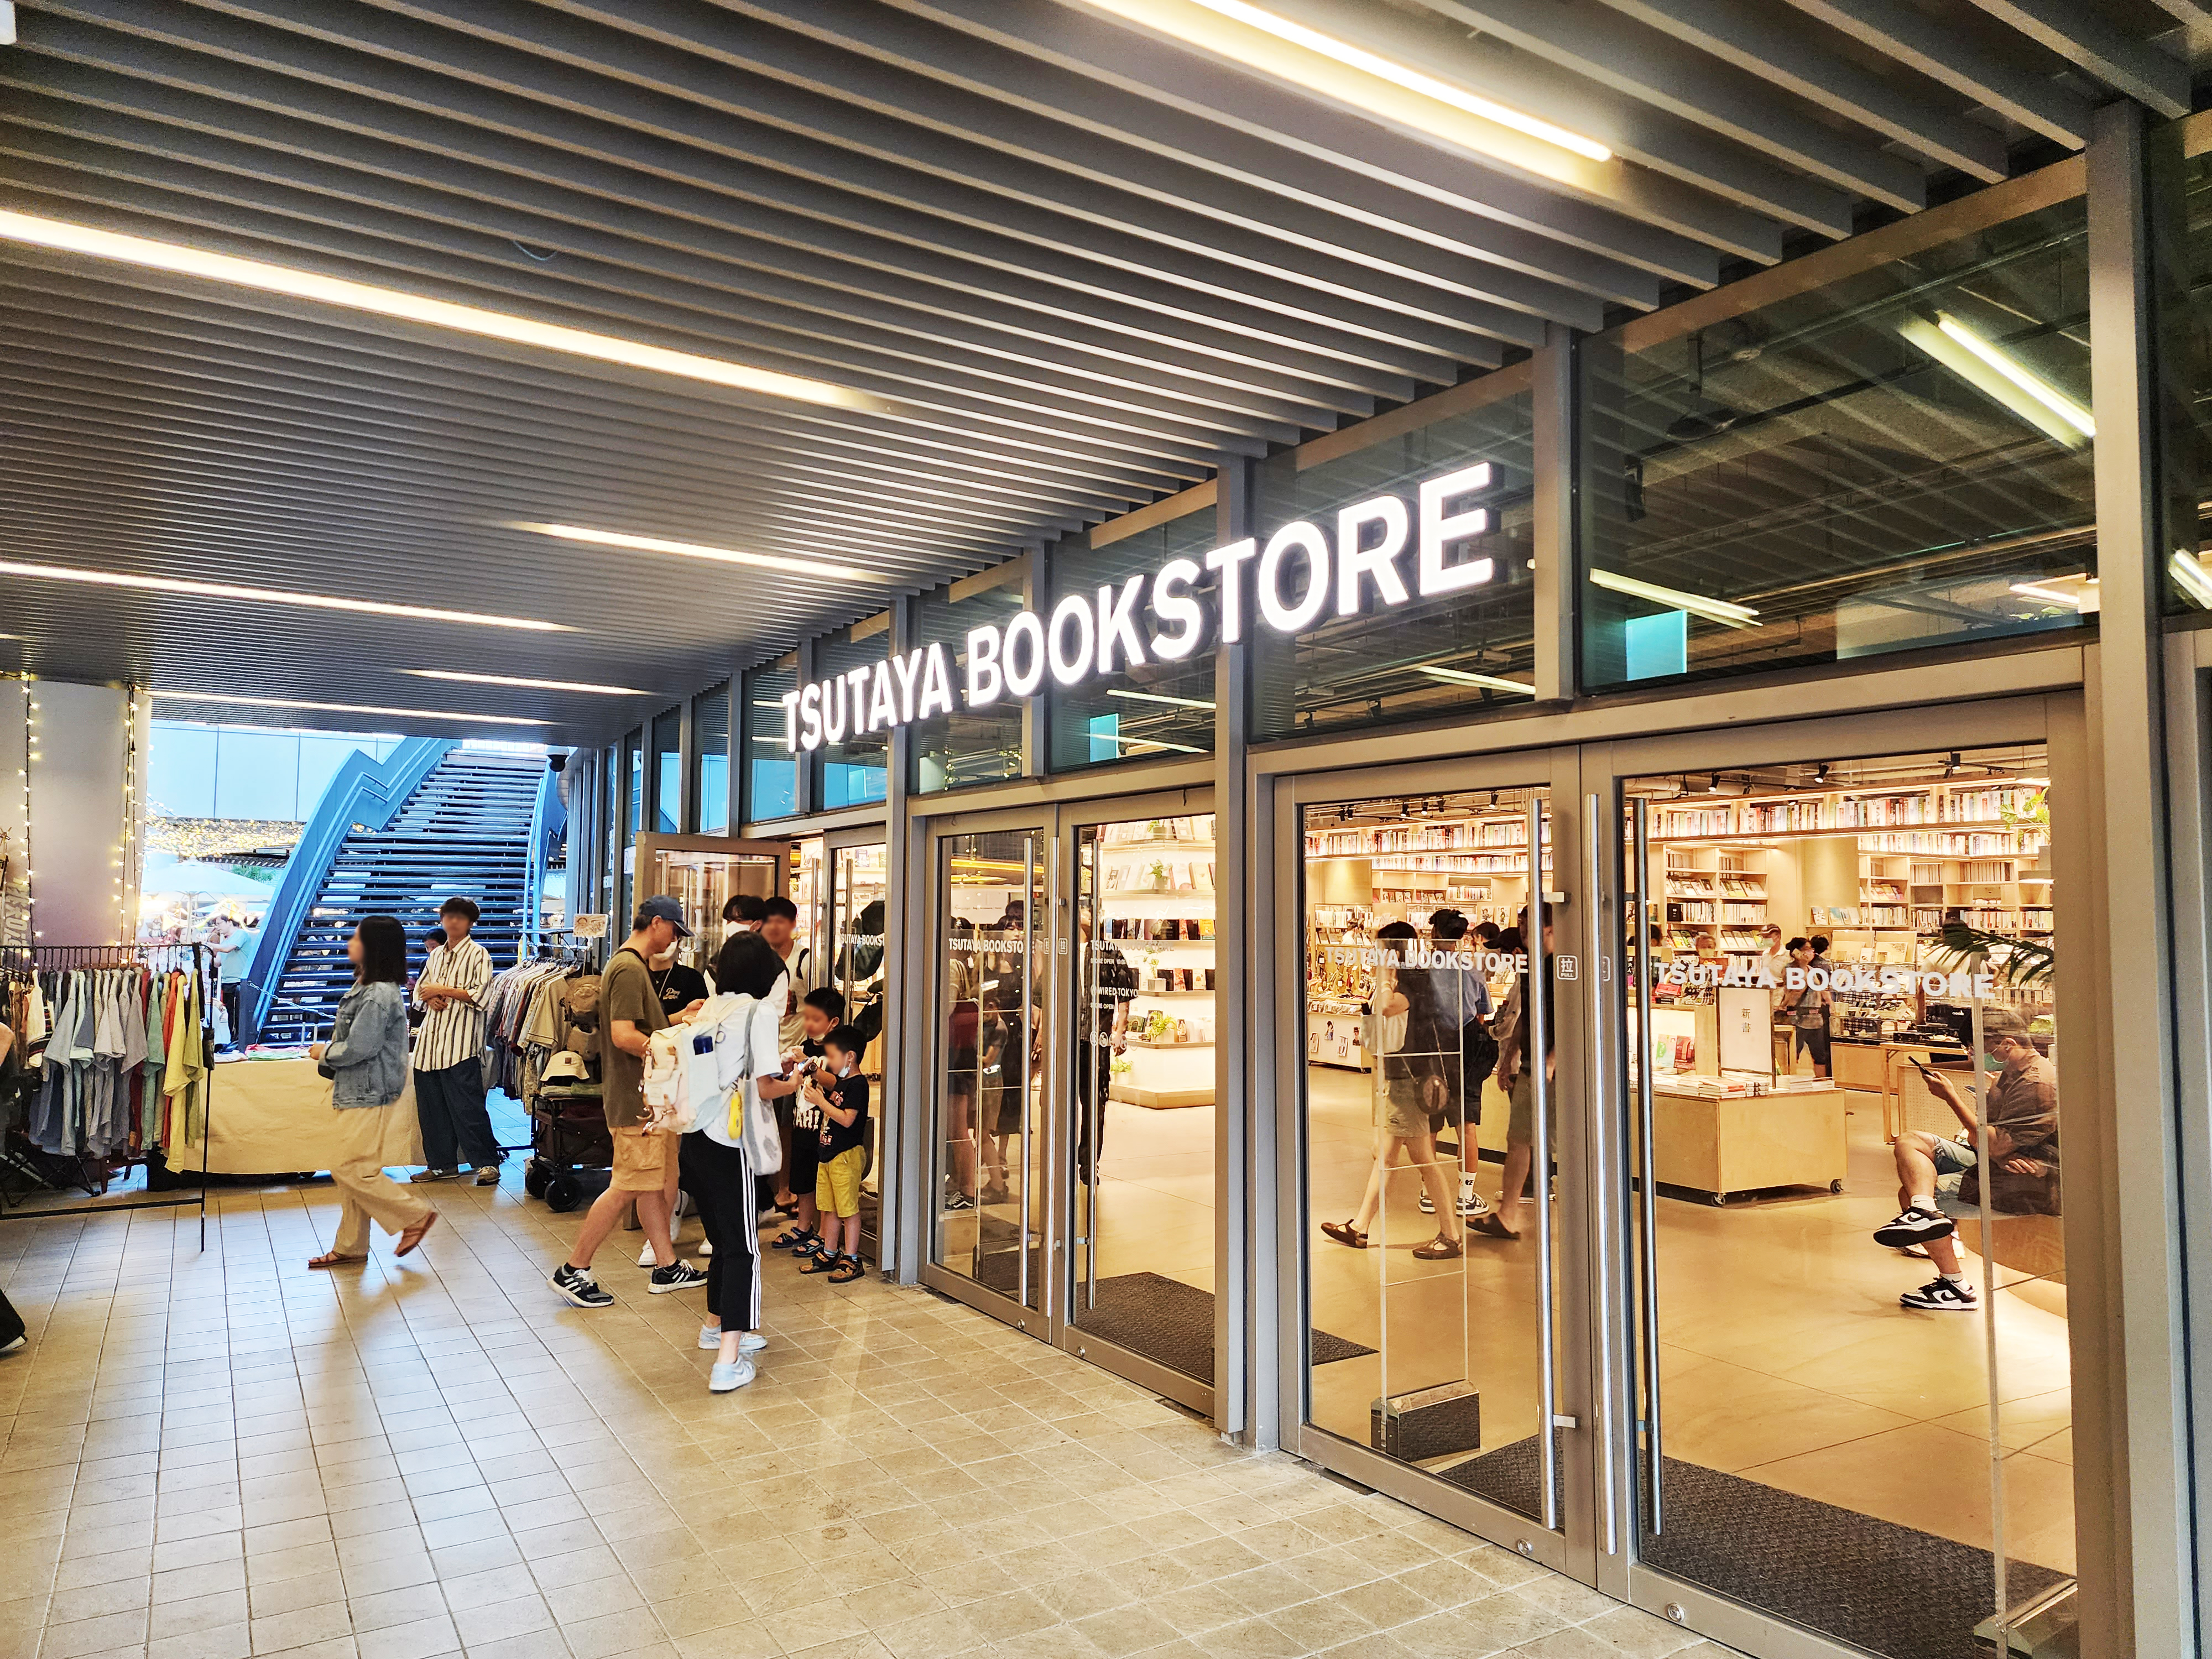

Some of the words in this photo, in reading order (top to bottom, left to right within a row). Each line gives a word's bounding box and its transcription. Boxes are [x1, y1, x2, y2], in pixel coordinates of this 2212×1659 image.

[781, 642, 952, 753] TSUTAYA
[967, 461, 1494, 711] BOOKSTORE
[840, 933, 862, 945] SUTAYA
[948, 938, 982, 953] TSUTAYA
[983, 939, 1035, 954] BOOKSTO
[1091, 940, 1123, 951] TSUTAYA
[1327, 947, 1400, 967] TSUTAYA
[1405, 950, 1528, 973] BOOKSTORE
[1560, 958, 1574, 972] 拉
[1655, 962, 1776, 989] TSUTAYA
[1786, 967, 1995, 999] BOOKSTORE
[1099, 986, 1117, 996] WIRED
[1118, 987, 1138, 997] TOKYO
